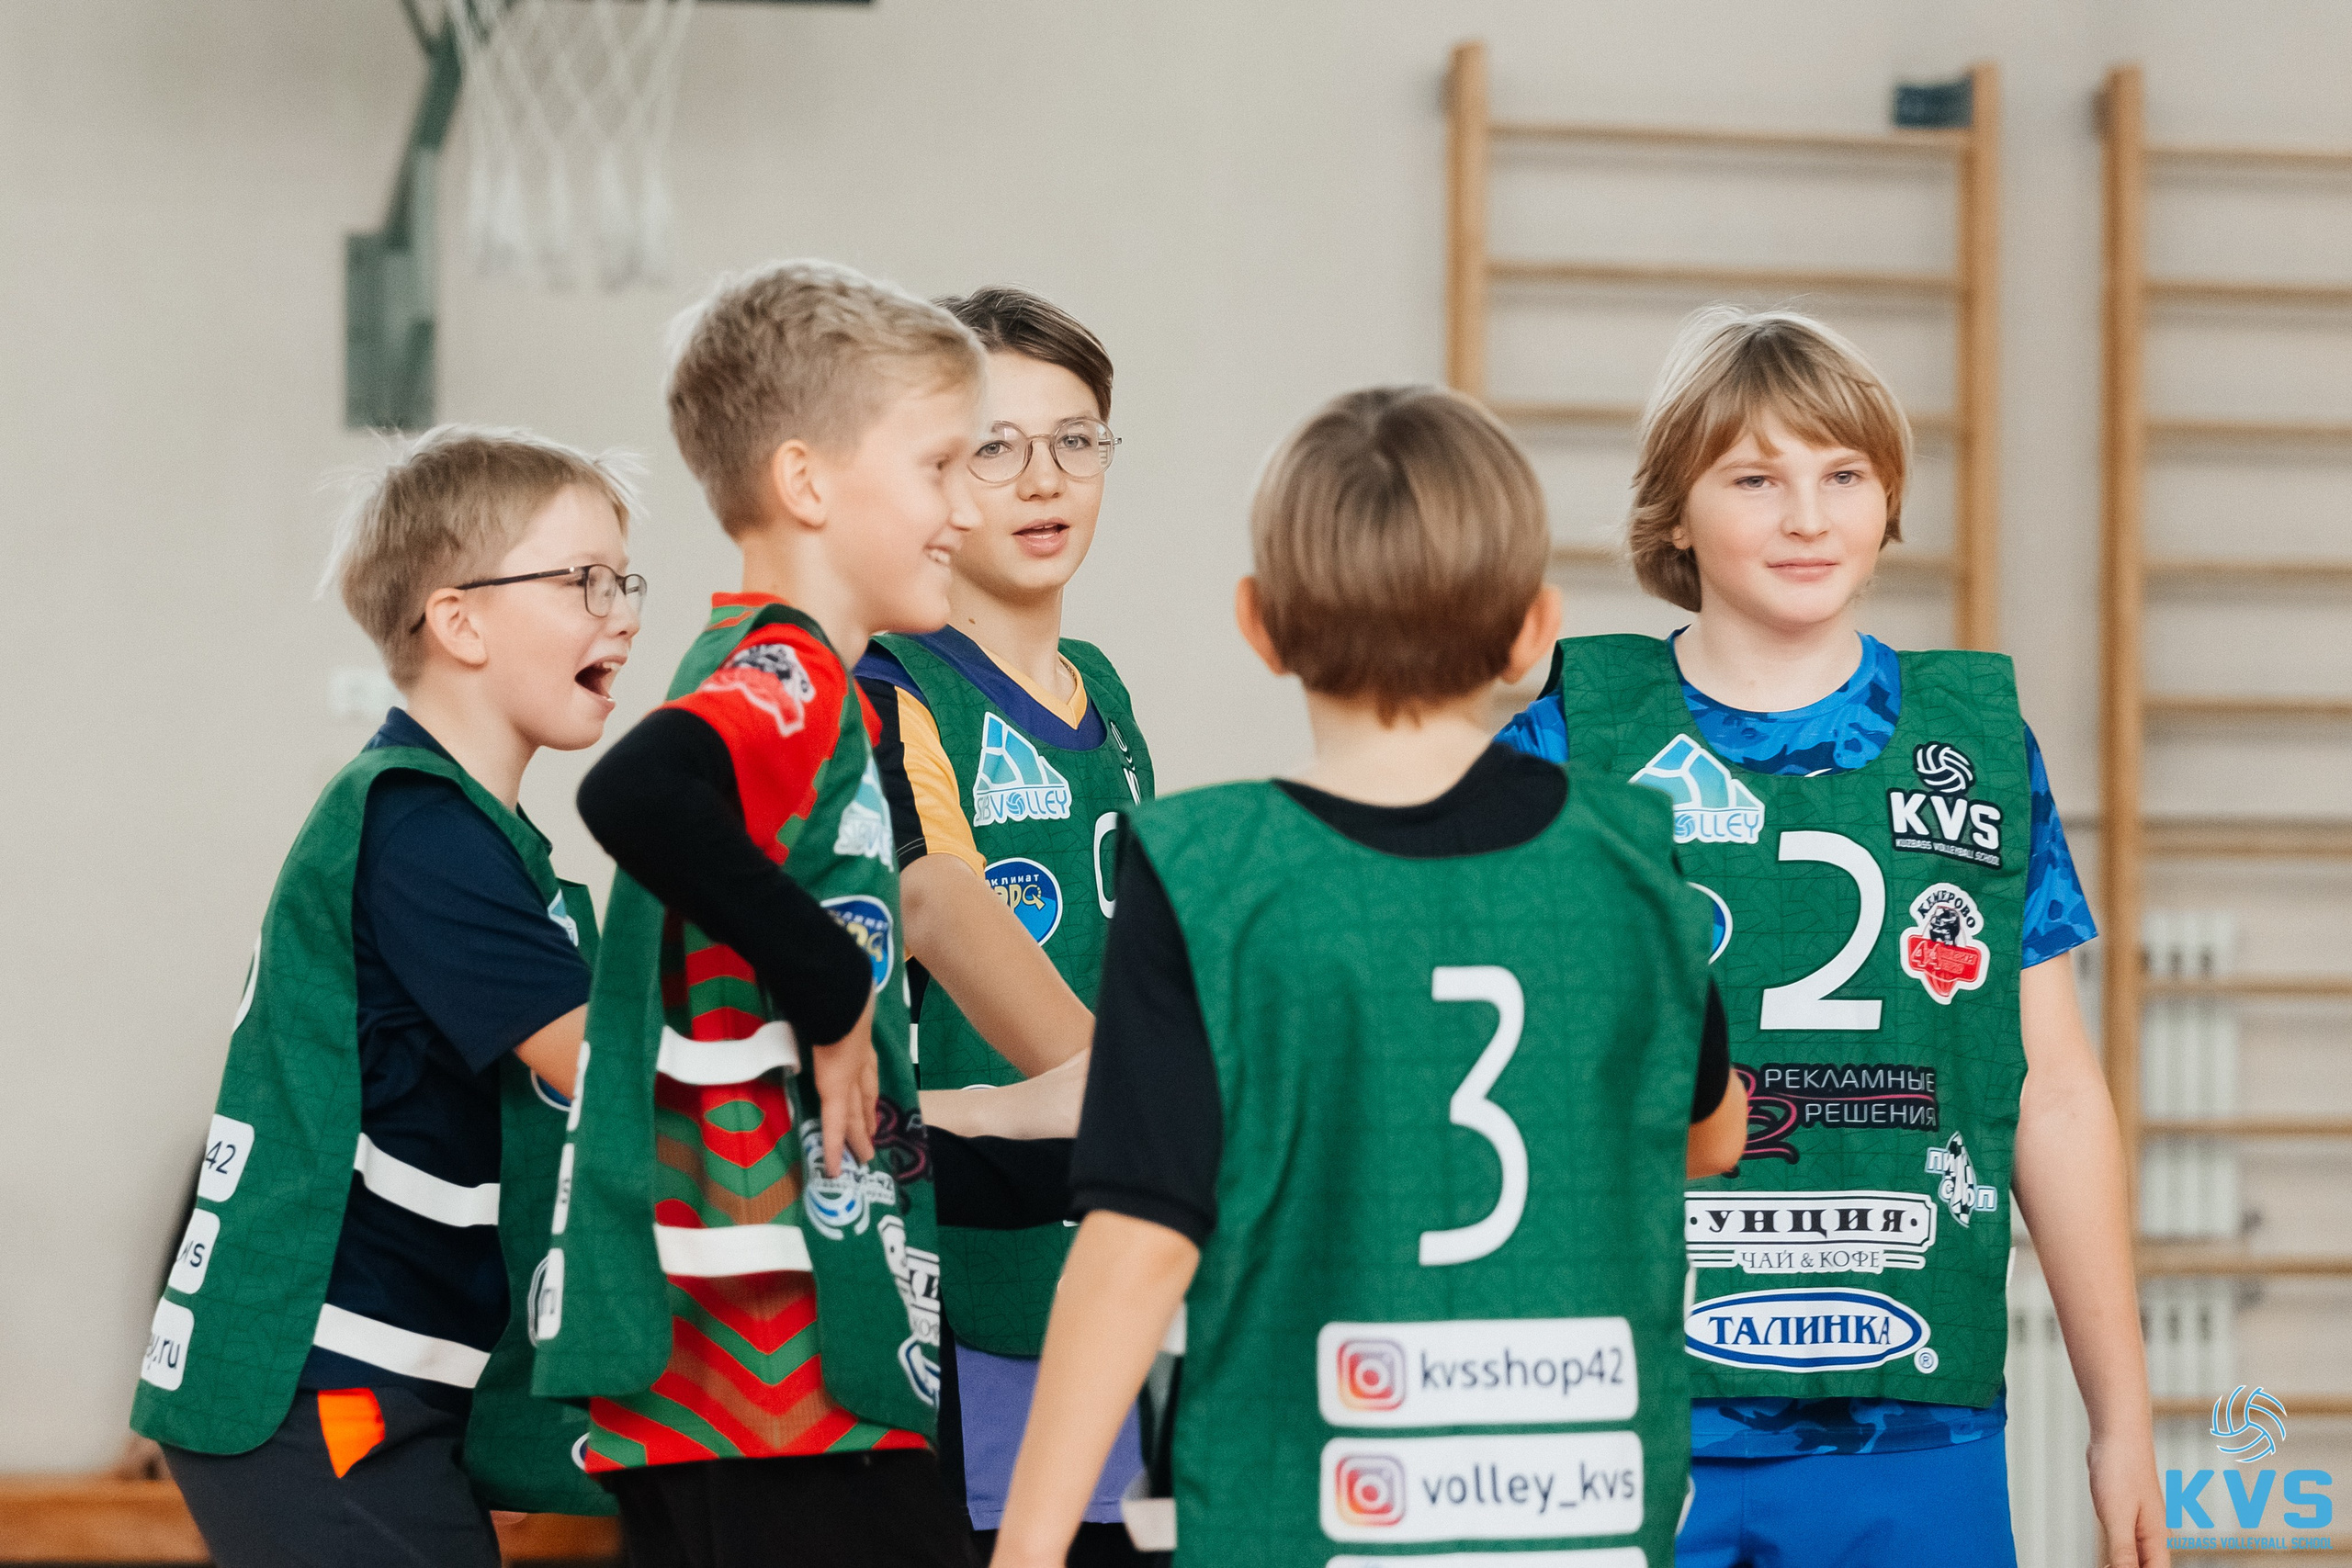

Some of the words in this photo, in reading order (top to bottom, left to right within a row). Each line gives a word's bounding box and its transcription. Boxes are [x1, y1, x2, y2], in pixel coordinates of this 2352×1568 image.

[1890, 791, 2001, 850] KVS
[1759, 830, 1886, 1030] 2
[1765, 1069, 1936, 1093] РЕКЛАМНЫЕ
[1419, 965, 1529, 1266] 3
[1805, 1103, 1937, 1127] РЕШЕНИЯ
[1705, 1209, 1907, 1238] УНЦИЯ
[1742, 1249, 1793, 1269] ЧАЙ
[1800, 1253, 1815, 1268] &
[1820, 1250, 1881, 1269] КОФЕ
[1708, 1315, 1891, 1346] ТАЛИНКА
[1421, 1348, 1623, 1395] kvsshop42
[1423, 1461, 1634, 1514] volley_kvs
